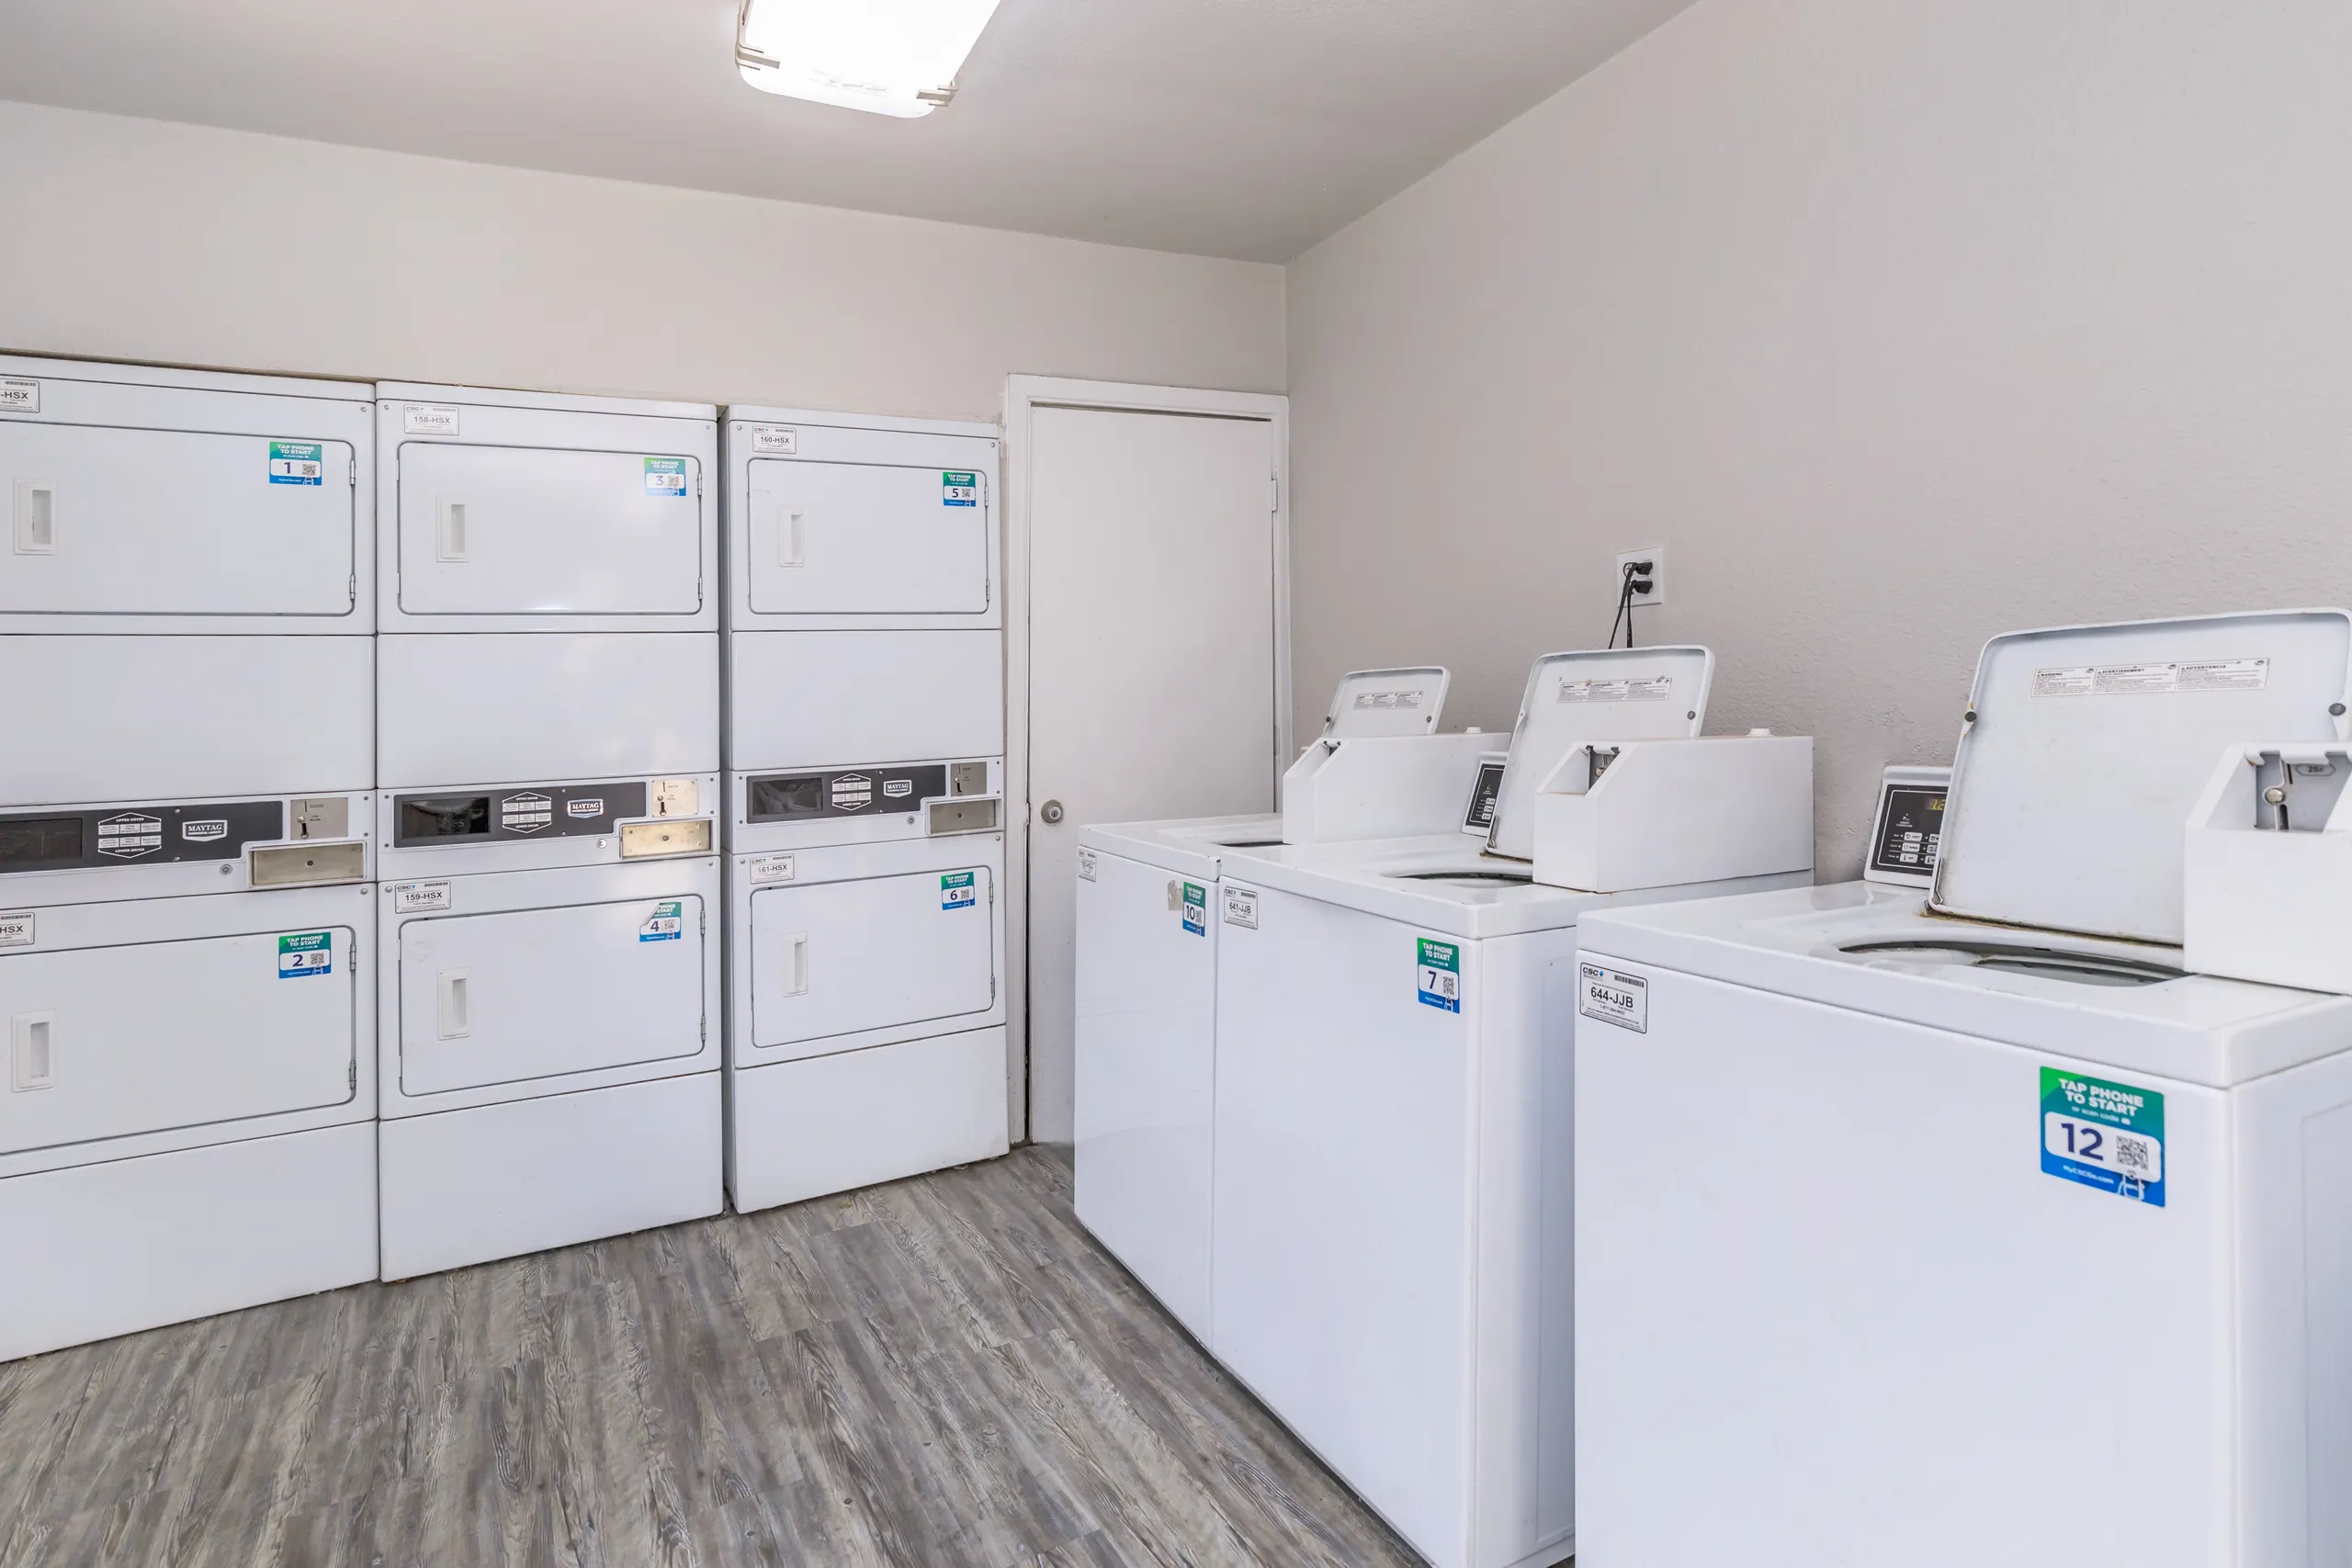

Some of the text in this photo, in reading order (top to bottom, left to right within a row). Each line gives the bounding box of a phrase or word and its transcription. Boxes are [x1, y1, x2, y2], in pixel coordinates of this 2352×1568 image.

[414, 416, 451, 424] 158-HSX
[284, 462, 291, 474] 1
[655, 475, 664, 486] 3
[952, 488, 959, 498] 5
[571, 802, 599, 810] MAYTAG
[187, 824, 222, 832] MAYTAG
[758, 864, 787, 874] 161-HSX
[405, 891, 443, 901] 159-HSX
[950, 889, 958, 900] 6
[1186, 905, 1195, 920] 10
[1228, 901, 1251, 914] 641-JJB
[650, 920, 660, 932] 4
[1422, 942, 1453, 955] TAP PHONE
[292, 953, 304, 967] 2
[1425, 949, 1451, 962] TO START
[1582, 966, 1599, 976] CSC
[1428, 970, 1437, 989] 7
[1590, 987, 1634, 1009] 644-JJB
[2058, 1077, 2144, 1108] TAP PHONE
[2064, 1090, 2138, 1117] TO START
[2060, 1122, 2104, 1161] 12
